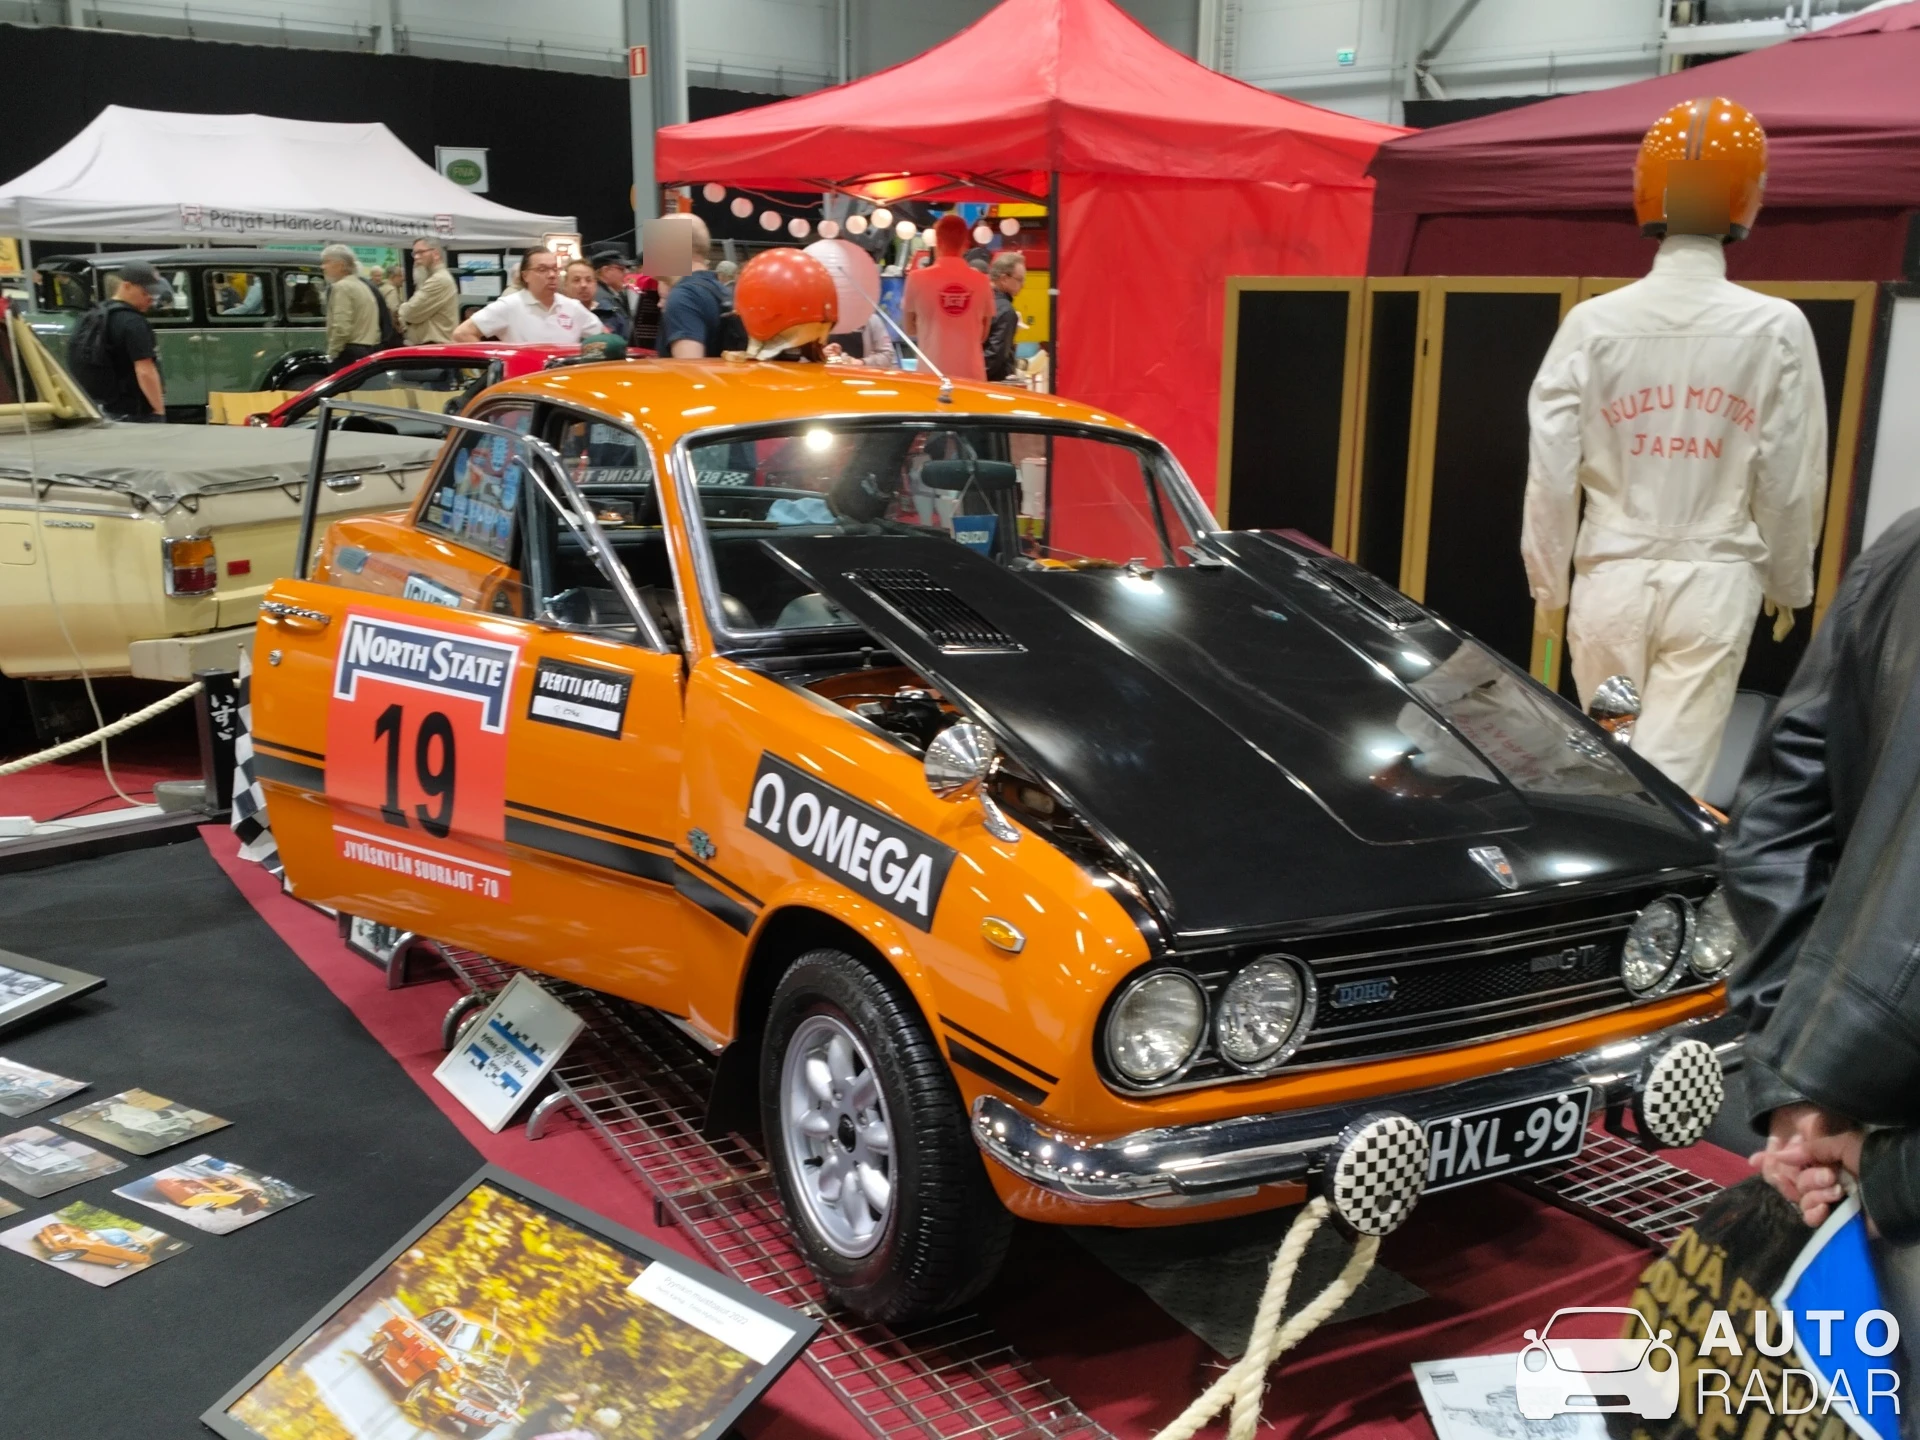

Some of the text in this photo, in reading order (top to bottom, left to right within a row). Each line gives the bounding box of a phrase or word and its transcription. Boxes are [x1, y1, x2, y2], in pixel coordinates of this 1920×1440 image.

[209, 209, 430, 236] Päijät-Hämeen Mobilistit
[1600, 384, 1675, 428] ISUZU
[1630, 433, 1723, 459] JAPAN
[347, 624, 504, 687] NORTH STATE
[539, 671, 622, 704] PERTTI KÄRHÄ
[374, 703, 456, 839] 19
[343, 840, 499, 898] JYVÄSKYLÄN SUURAJOT -70
[787, 792, 933, 916] OMEGA
[1340, 982, 1389, 1002] DOHC
